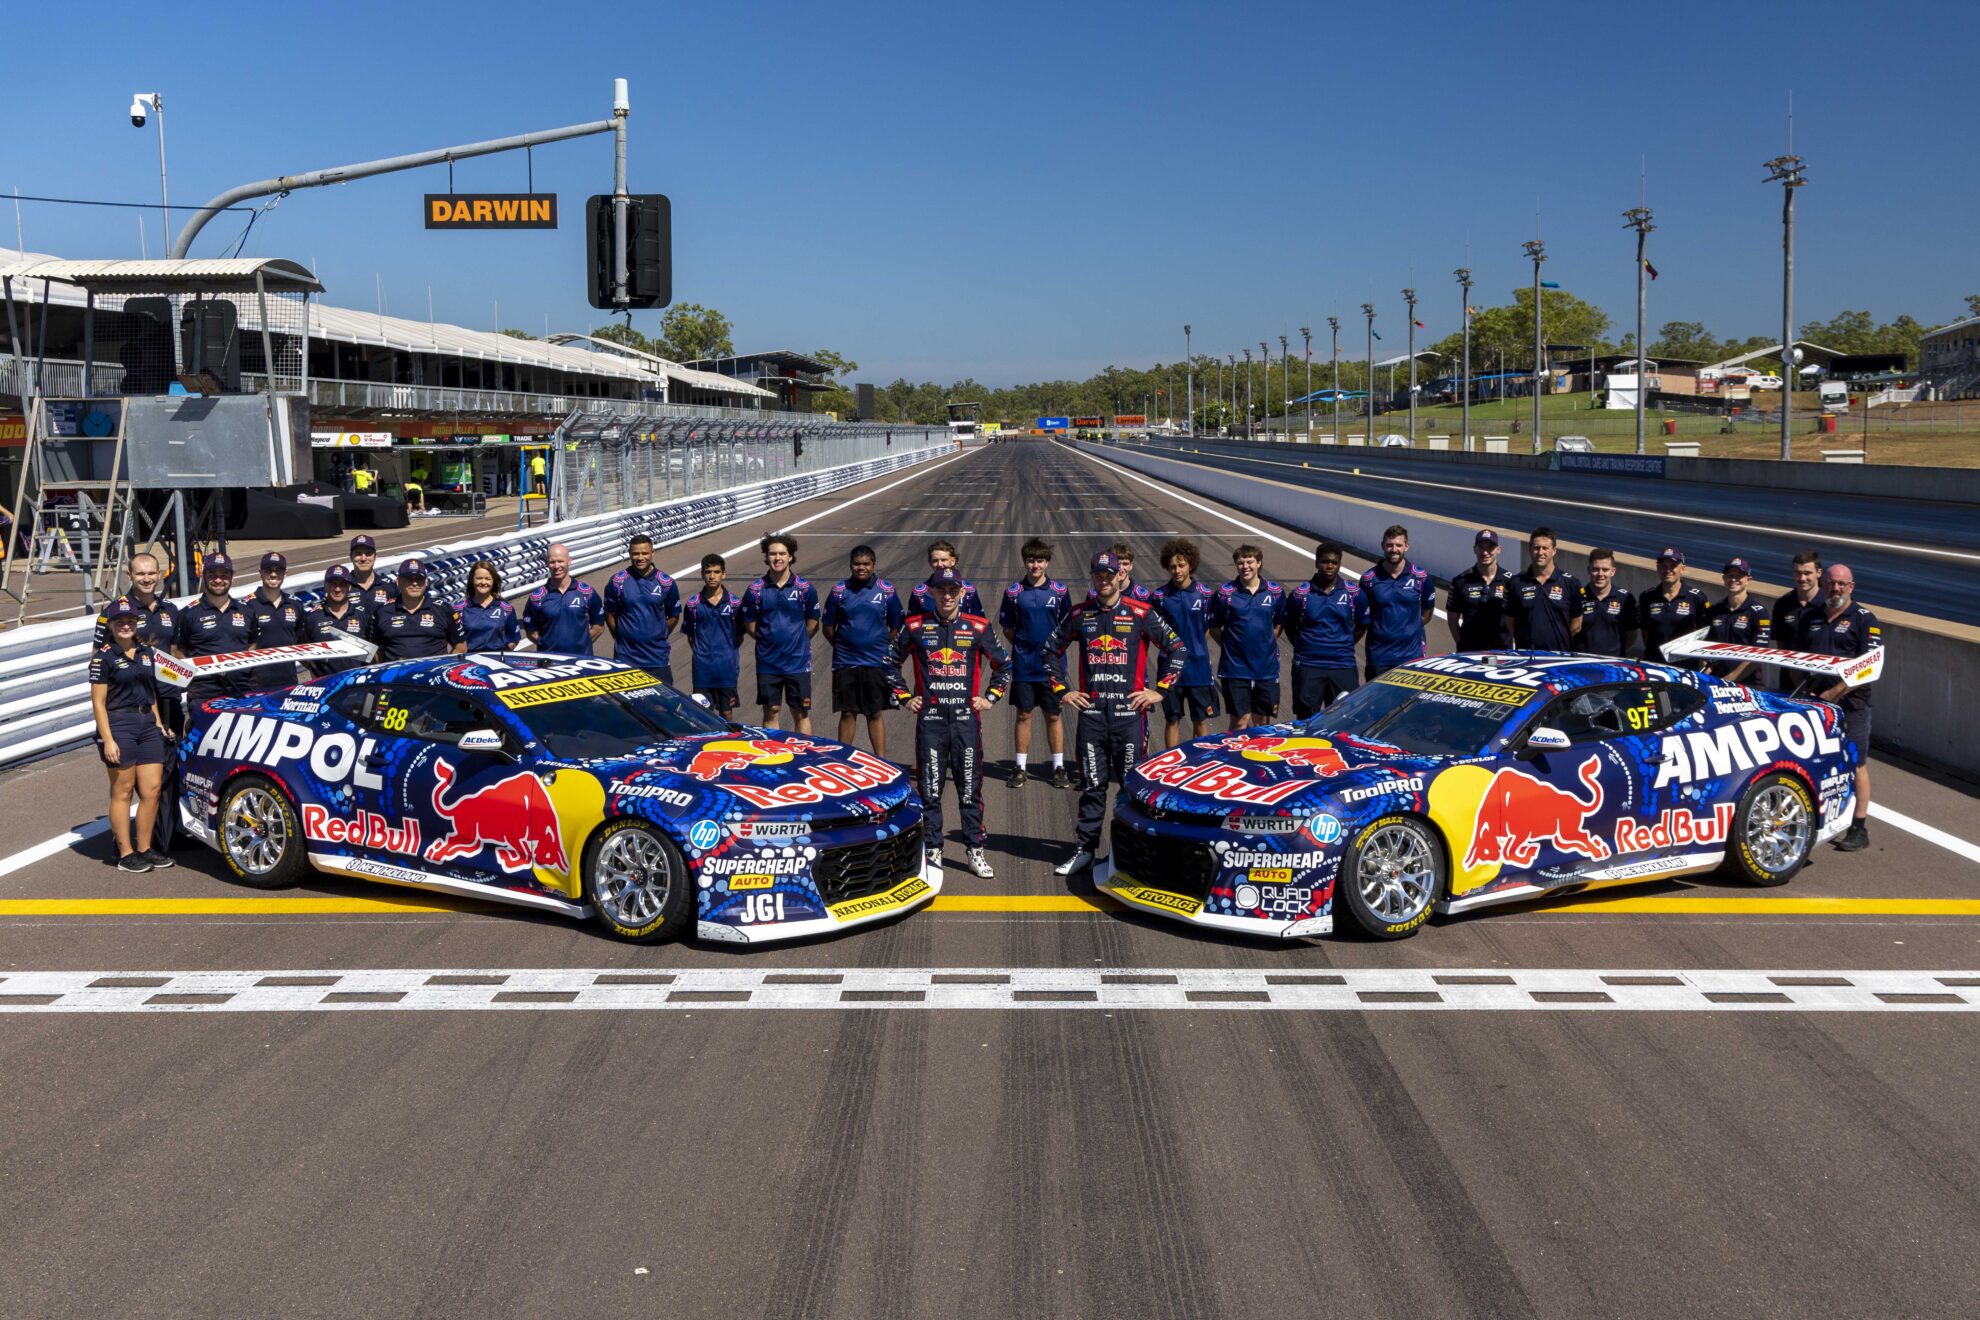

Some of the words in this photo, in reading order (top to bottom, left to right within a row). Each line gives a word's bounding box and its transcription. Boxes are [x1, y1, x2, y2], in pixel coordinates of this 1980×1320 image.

[432, 200, 550, 221] DARWIN
[199, 653, 294, 672] Premium
[216, 641, 333, 664] AMPLIFY
[1088, 653, 1107, 664] Red
[1107, 653, 1127, 664] Bull
[1689, 649, 1774, 663] Premium
[1779, 657, 1833, 672] Fuels
[1726, 644, 1853, 665] AMPLIFY
[155, 653, 194, 680] SUPERCHEAP
[488, 659, 632, 689] AMPOL
[929, 665, 947, 676] Red
[947, 665, 966, 676] Bull
[1404, 657, 1547, 687] AMPOL
[1843, 651, 1882, 679] SUPERCHEAP
[290, 685, 326, 699] Harvey
[502, 680, 597, 705] NATIONAL
[594, 671, 657, 691] STORAGE
[621, 687, 661, 700] Feeney
[1440, 679, 1528, 703] STORAGE
[1712, 685, 1745, 699] Harvey
[279, 698, 321, 713] Norman
[1431, 693, 1485, 709] Gisbergen
[1714, 700, 1755, 715] Norman
[383, 707, 409, 731] 88
[1627, 706, 1650, 730] 97
[197, 712, 383, 790] AMPOL
[1458, 756, 1497, 765] DUNLOP
[1653, 709, 1840, 789] AMPOL
[930, 756, 939, 798] AMPLIFY
[1088, 750, 1099, 787] AMPLIF
[1136, 748, 1225, 788] Red
[714, 766, 859, 810] Red
[817, 750, 902, 790] Bull
[1180, 765, 1322, 806] Bull
[1340, 777, 1424, 804] ToolPRO
[607, 779, 694, 807] ToolPRO
[302, 803, 366, 846] Red
[365, 812, 422, 857] Bull
[602, 818, 650, 839] DUNLOP
[1316, 815, 1336, 842] hp
[1378, 816, 1404, 829] MAXX
[1614, 809, 1670, 854] Red
[1671, 802, 1736, 847] Bull
[695, 822, 717, 848] hp
[703, 856, 807, 876] SUPERCHEAP
[1223, 850, 1324, 870] SUPERCHEAP
[1621, 863, 1643, 876] NEW
[1642, 857, 1688, 873] HOLLAND
[357, 862, 383, 875] NEW
[378, 866, 428, 883] HOLLAND
[734, 876, 769, 887] AUTO
[1253, 870, 1287, 880] AUTO
[833, 895, 896, 918] NATIONAL
[895, 880, 928, 902] STORAGE
[1140, 890, 1198, 912] STORAGE
[1261, 885, 1312, 901] QUAD
[741, 892, 785, 924] JGI
[1261, 900, 1311, 915] LOCK
[1386, 905, 1433, 934] DUNLOP
